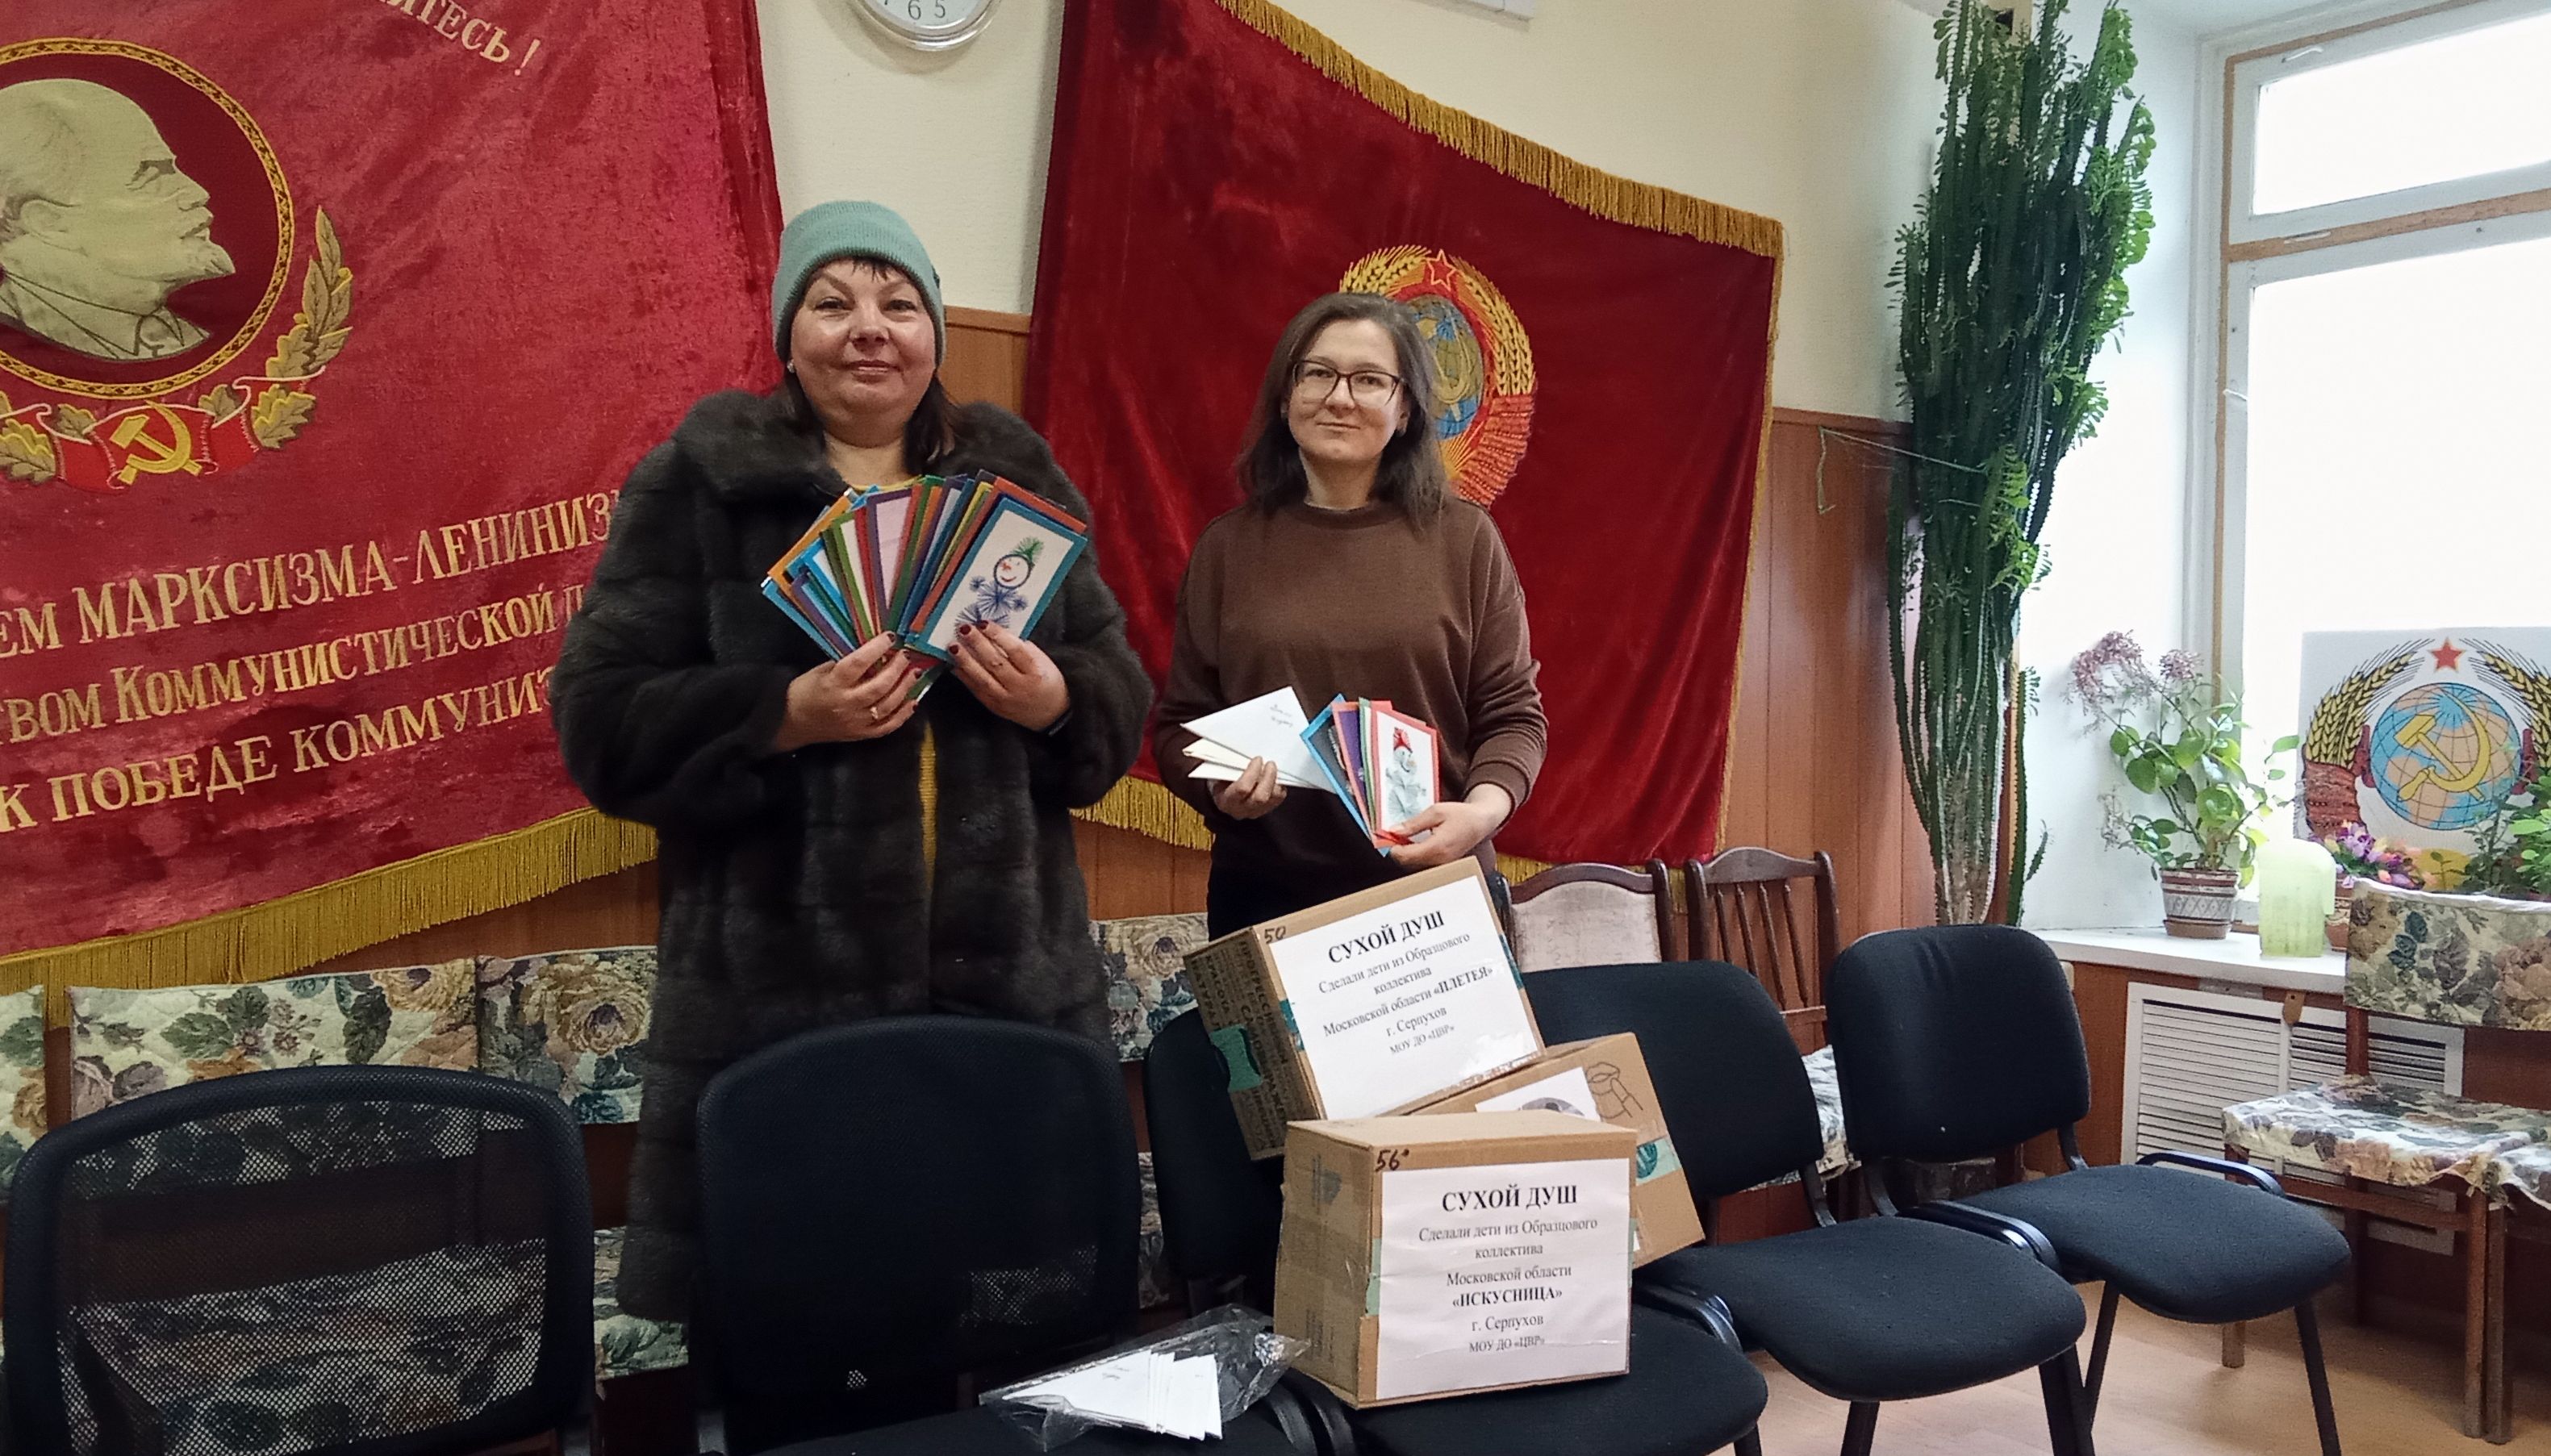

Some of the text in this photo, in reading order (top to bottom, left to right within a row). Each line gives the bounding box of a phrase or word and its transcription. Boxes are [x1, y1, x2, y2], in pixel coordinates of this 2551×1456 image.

[72, 489, 620, 644] МАРКСИЗМА-ЛЕНИНИЗ
[0, 683, 107, 745] ВОМ
[0, 783, 38, 832] К
[47, 736, 278, 821] ПОБЕДЕ
[1263, 925, 1286, 945] 50
[1329, 910, 1444, 963] СУХОЙ ДУШ
[1318, 934, 1470, 994] Сделали дети из Образцового
[1374, 967, 1432, 995] коллектива
[1323, 966, 1493, 1037] Московской области «ПЛЕТЕЯ»
[1397, 1008, 1447, 1033] Серпухов
[1389, 1041, 1411, 1054] МОУ
[1413, 1034, 1427, 1048] ДО
[1443, 1183, 1577, 1212] СУХОЙ ДУШ
[1418, 1219, 1598, 1242] Сделали дети из Образцового
[1475, 1245, 1543, 1259] коллектива
[1447, 1265, 1572, 1286] Московской области
[1452, 1286, 1562, 1308] «ИСКУСНИЦА»
[1472, 1315, 1544, 1333] г. Серпухов
[1469, 1340, 1493, 1354] МОУ
[1496, 1338, 1512, 1352] ДО
